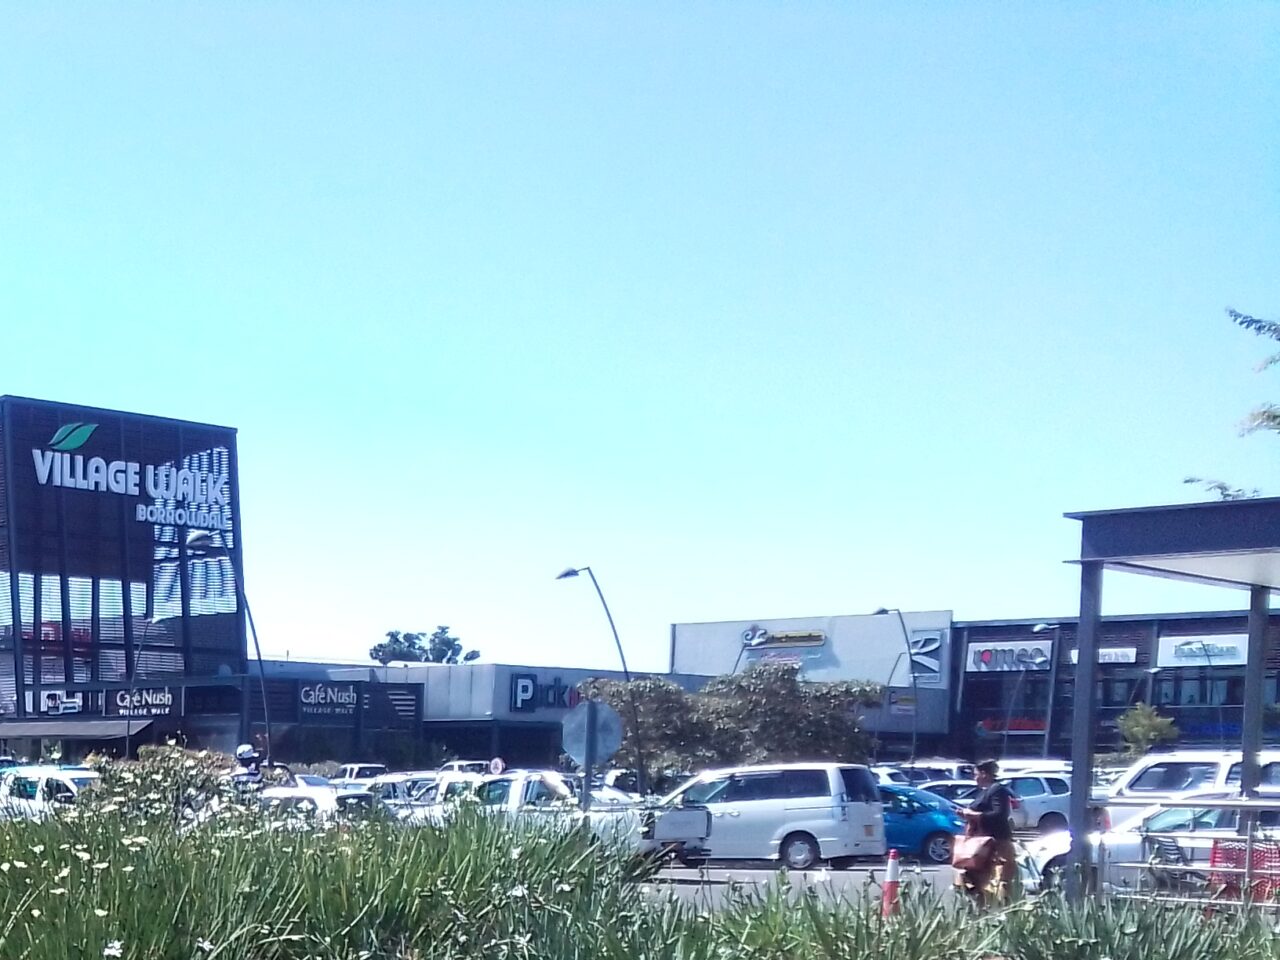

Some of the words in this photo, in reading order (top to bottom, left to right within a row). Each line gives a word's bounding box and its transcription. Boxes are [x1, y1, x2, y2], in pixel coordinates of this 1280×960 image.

[32, 449, 140, 496] VILLAGE
[145, 464, 230, 505] WALK
[135, 503, 232, 531] BORROWDALE
[141, 685, 173, 706] Nush
[301, 683, 325, 704] Café
[326, 685, 357, 704] Nush
